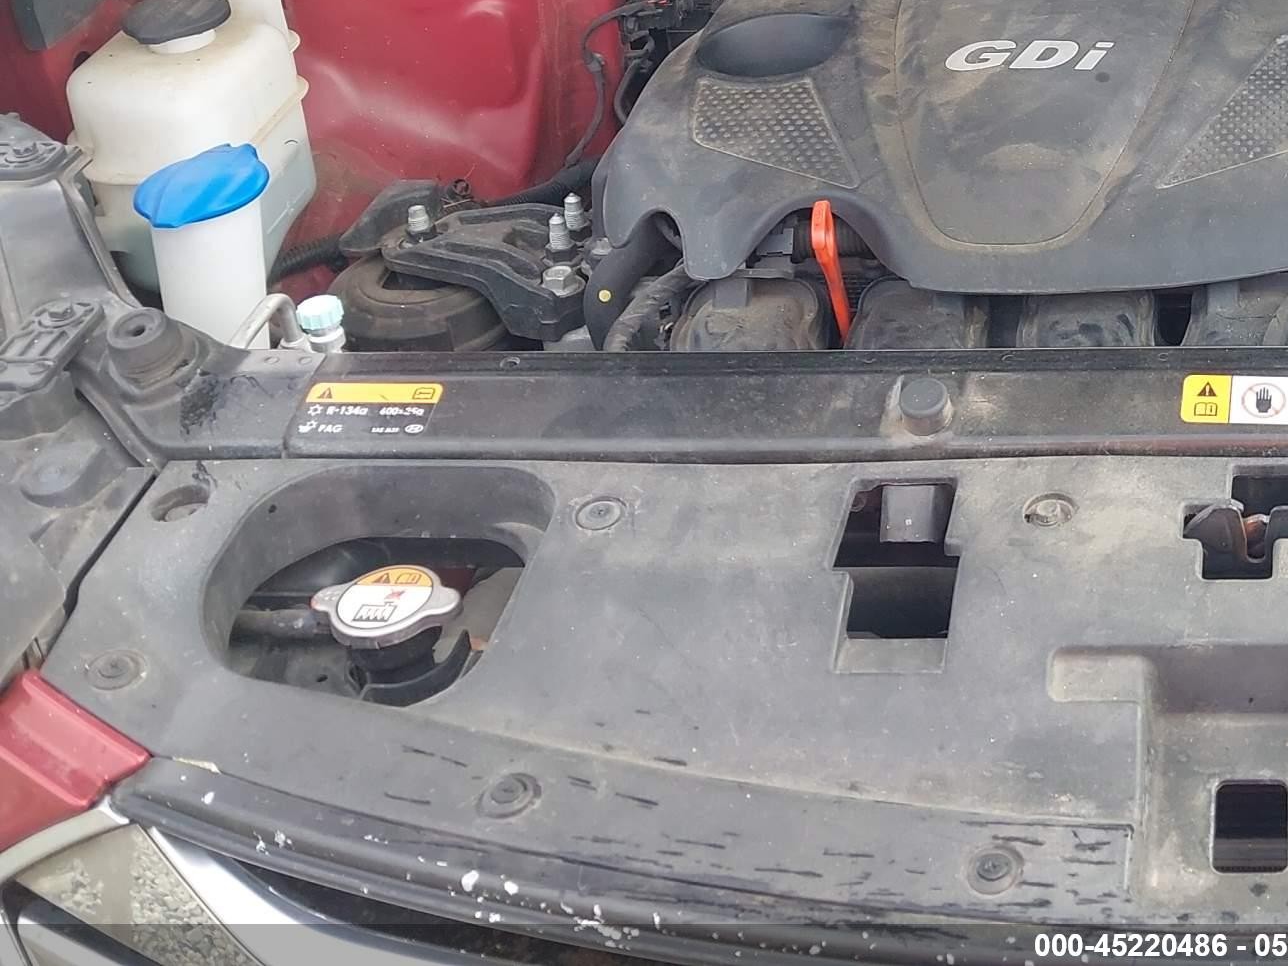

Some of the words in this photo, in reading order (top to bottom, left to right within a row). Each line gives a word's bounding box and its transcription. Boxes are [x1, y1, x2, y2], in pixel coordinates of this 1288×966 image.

[944, 40, 1115, 71] GDi
[326, 405, 369, 416] R-134a
[317, 424, 343, 433] PAG
